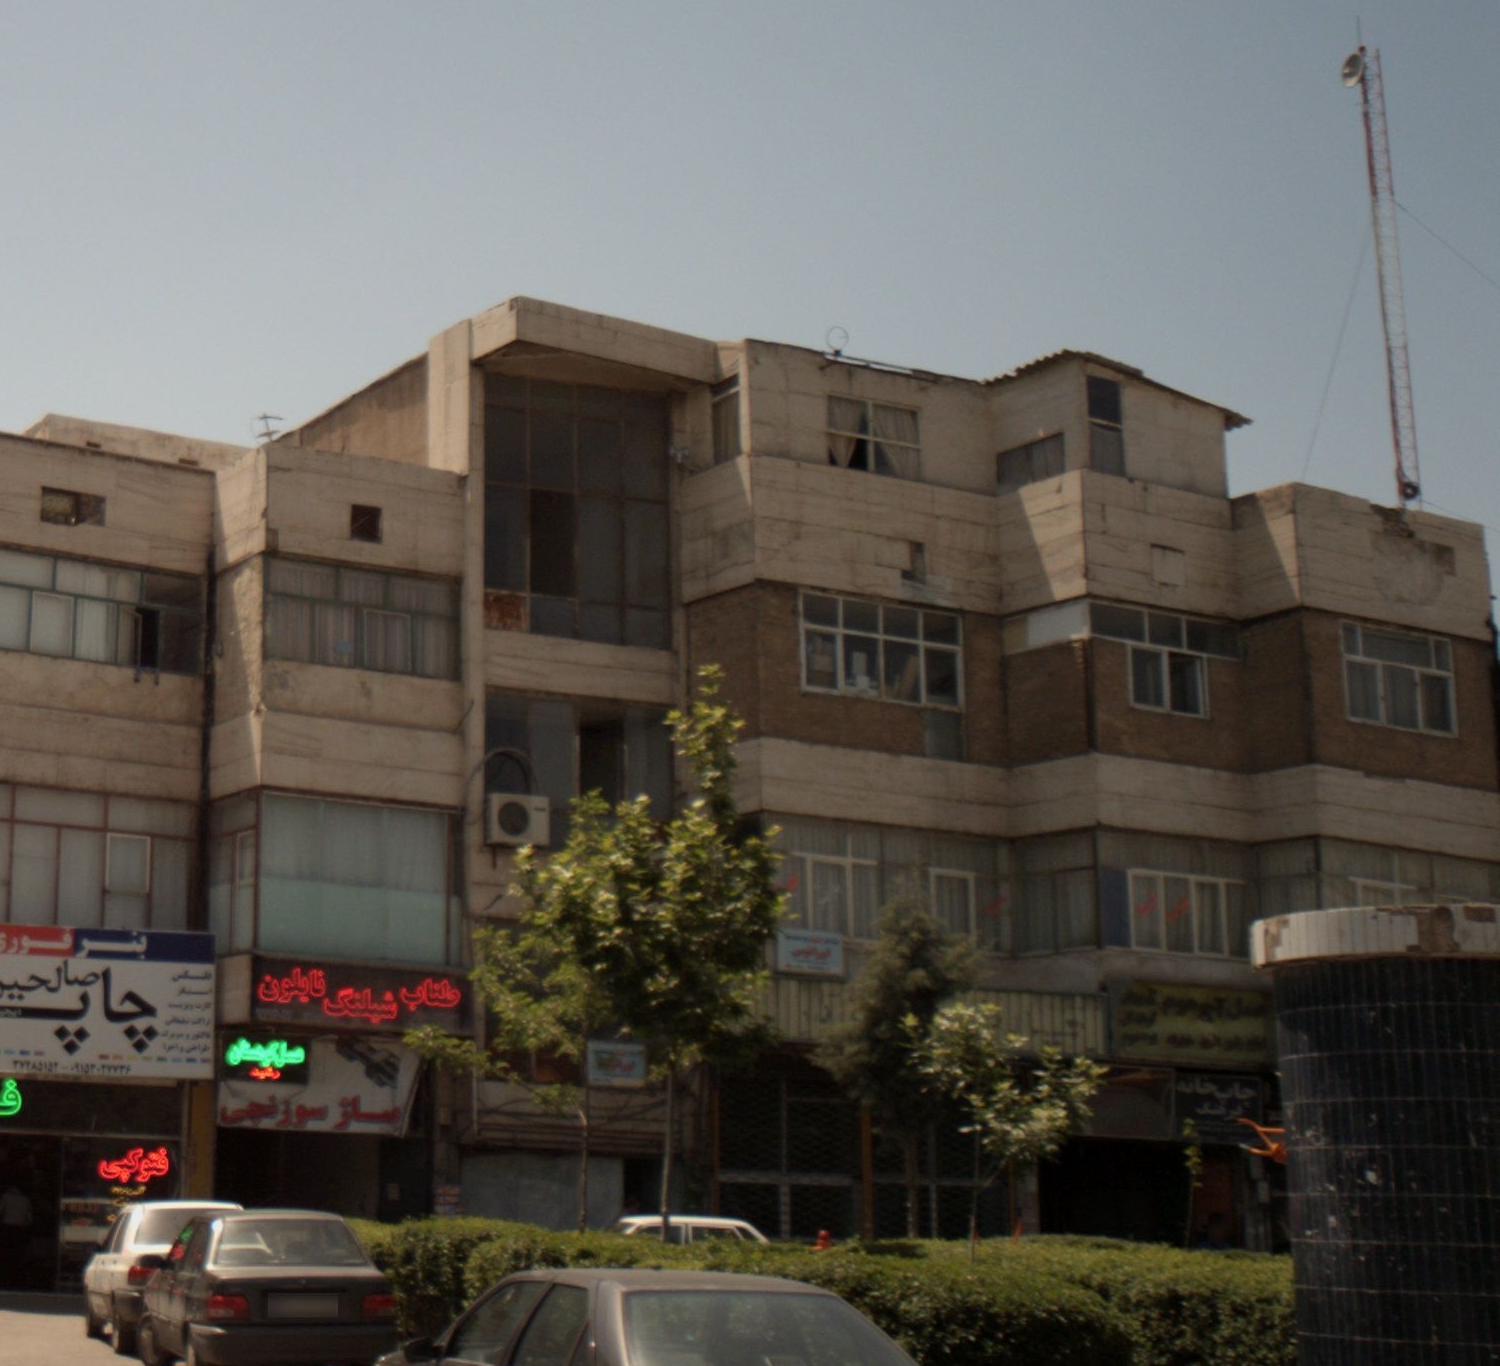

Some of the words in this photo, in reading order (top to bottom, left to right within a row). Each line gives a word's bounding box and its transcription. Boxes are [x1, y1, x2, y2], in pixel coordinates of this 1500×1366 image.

[75, 930, 148, 961] بنر
[323, 987, 399, 1024] شیلنگ
[99, 1147, 169, 1184] فتوکپی
